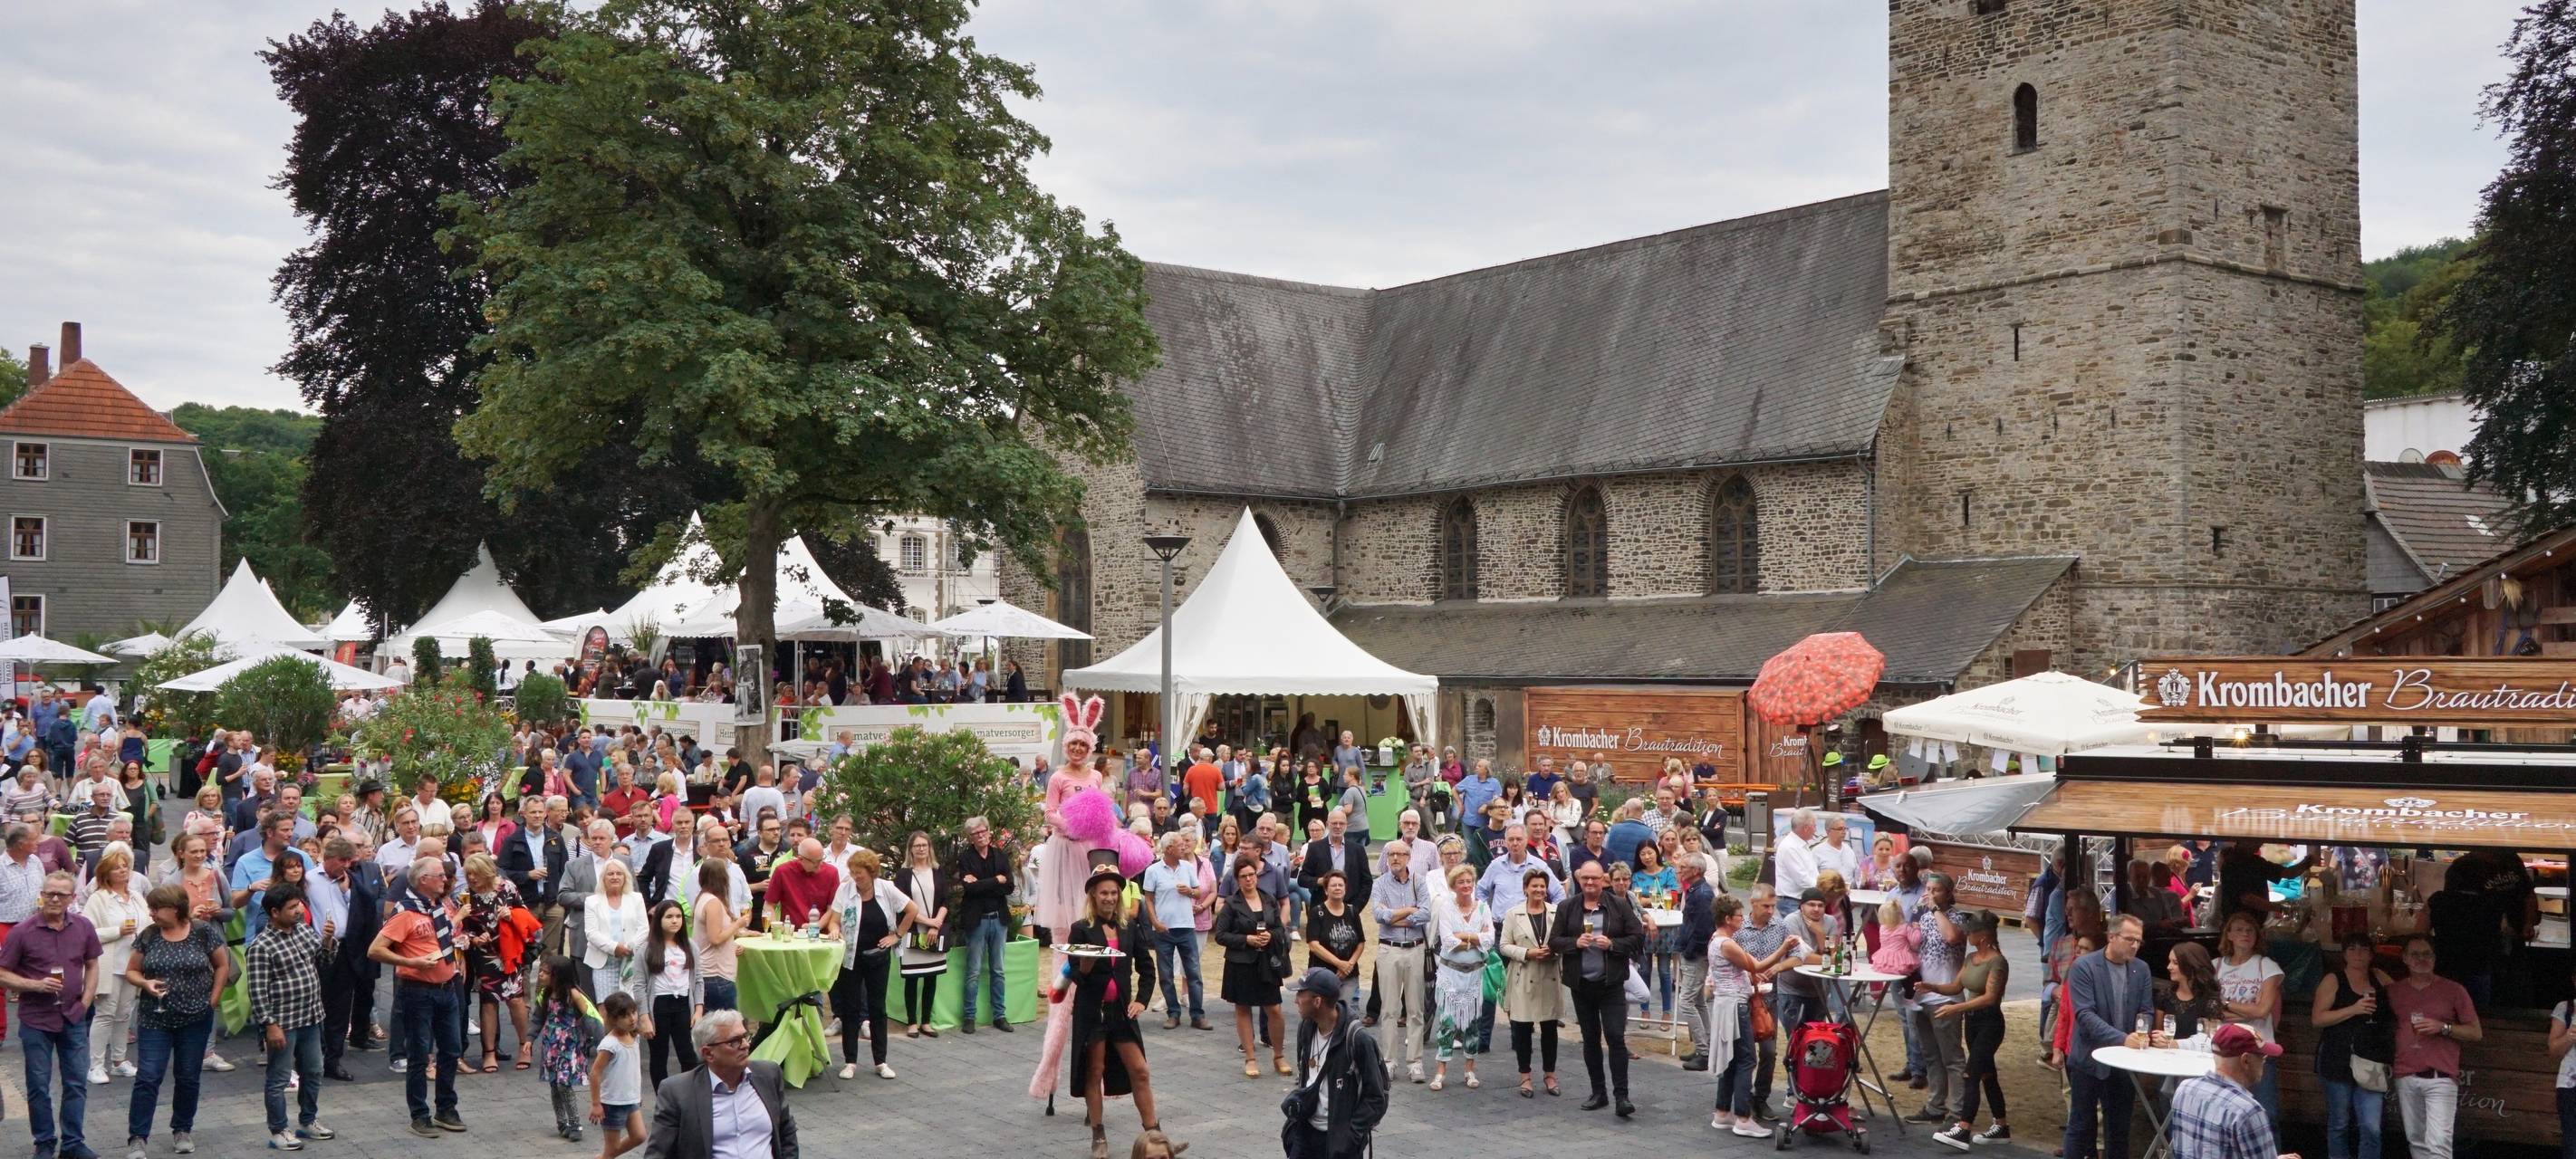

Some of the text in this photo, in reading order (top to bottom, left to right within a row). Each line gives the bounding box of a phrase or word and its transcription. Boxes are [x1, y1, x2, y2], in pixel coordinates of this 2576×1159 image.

[2197, 670, 2372, 708] Krombacher
[1553, 726, 1724, 759] Krombacher Brautradition
[1769, 742, 1804, 757] Braut
[2296, 804, 2529, 819] Krombacher
[1967, 869, 2007, 885] Krombacher
[1956, 876, 2017, 899] Brautradition
